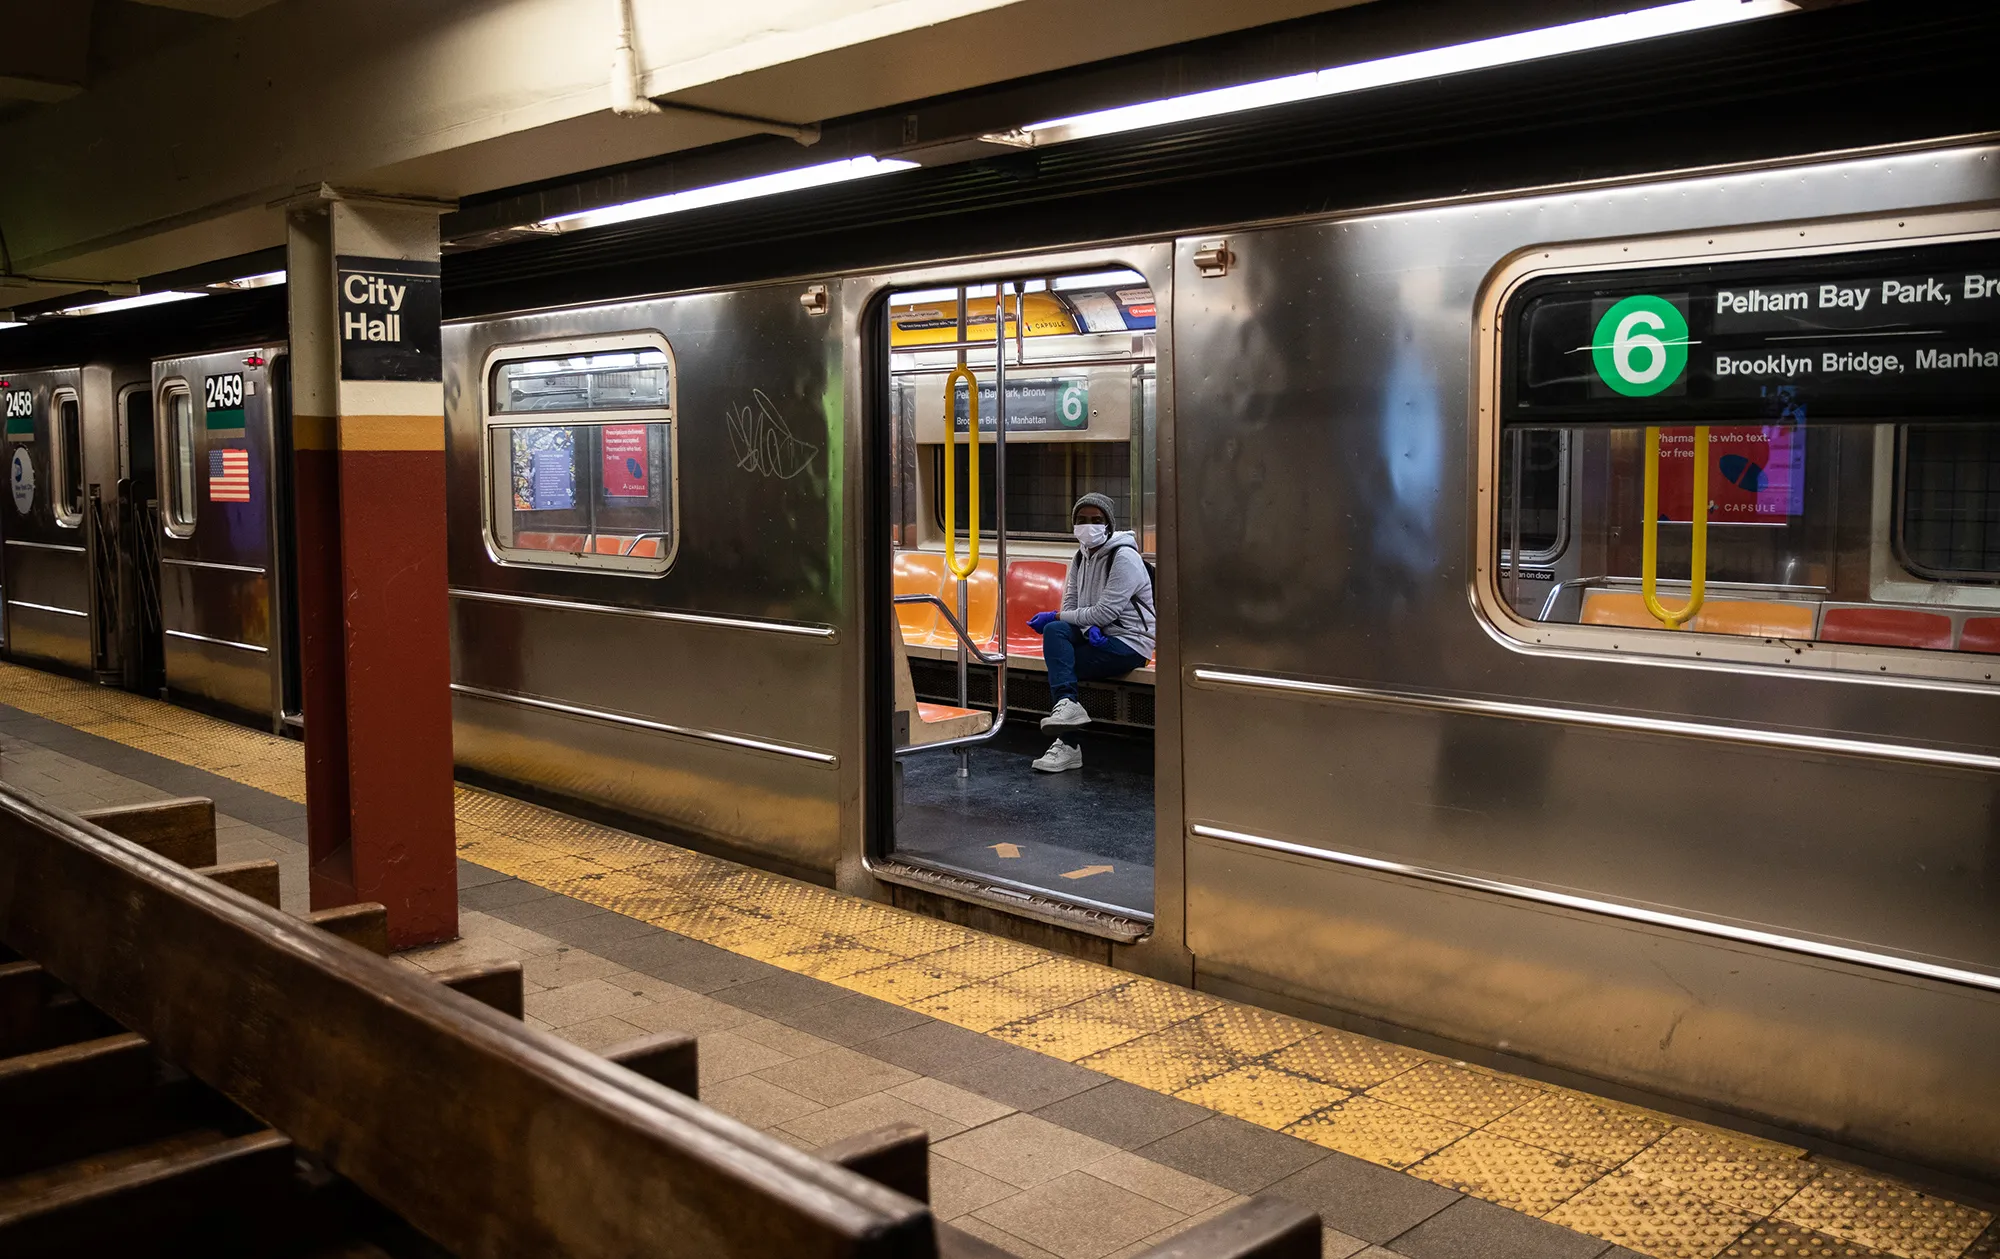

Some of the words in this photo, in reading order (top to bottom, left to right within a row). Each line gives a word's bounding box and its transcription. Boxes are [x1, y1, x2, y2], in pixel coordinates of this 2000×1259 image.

[344, 274, 406, 312] City
[1717, 287, 1808, 315] Pelham
[1819, 284, 1870, 311] Bay
[1882, 278, 1951, 306] Park,
[1964, 274, 2000, 299] Br
[345, 311, 400, 342] Hall
[1035, 321, 1066, 329] CAPSULE
[1613, 310, 1666, 385] 6
[1717, 355, 1813, 376] Brooklyn
[1823, 352, 1904, 374] Bridge,
[1916, 348, 2000, 369] Manha
[6, 391, 33, 417] 2458
[206, 374, 243, 409] 2459
[984, 388, 997, 400] Bay
[1005, 388, 1021, 399] ark,
[1022, 387, 1046, 397] Bronx
[1063, 387, 1082, 421] 6
[1011, 416, 1047, 425] Manhattan
[1720, 433, 1744, 442] who
[1745, 433, 1771, 442] text.
[1724, 503, 1776, 513] CAPSULE
[1536, 572, 1551, 580] door
